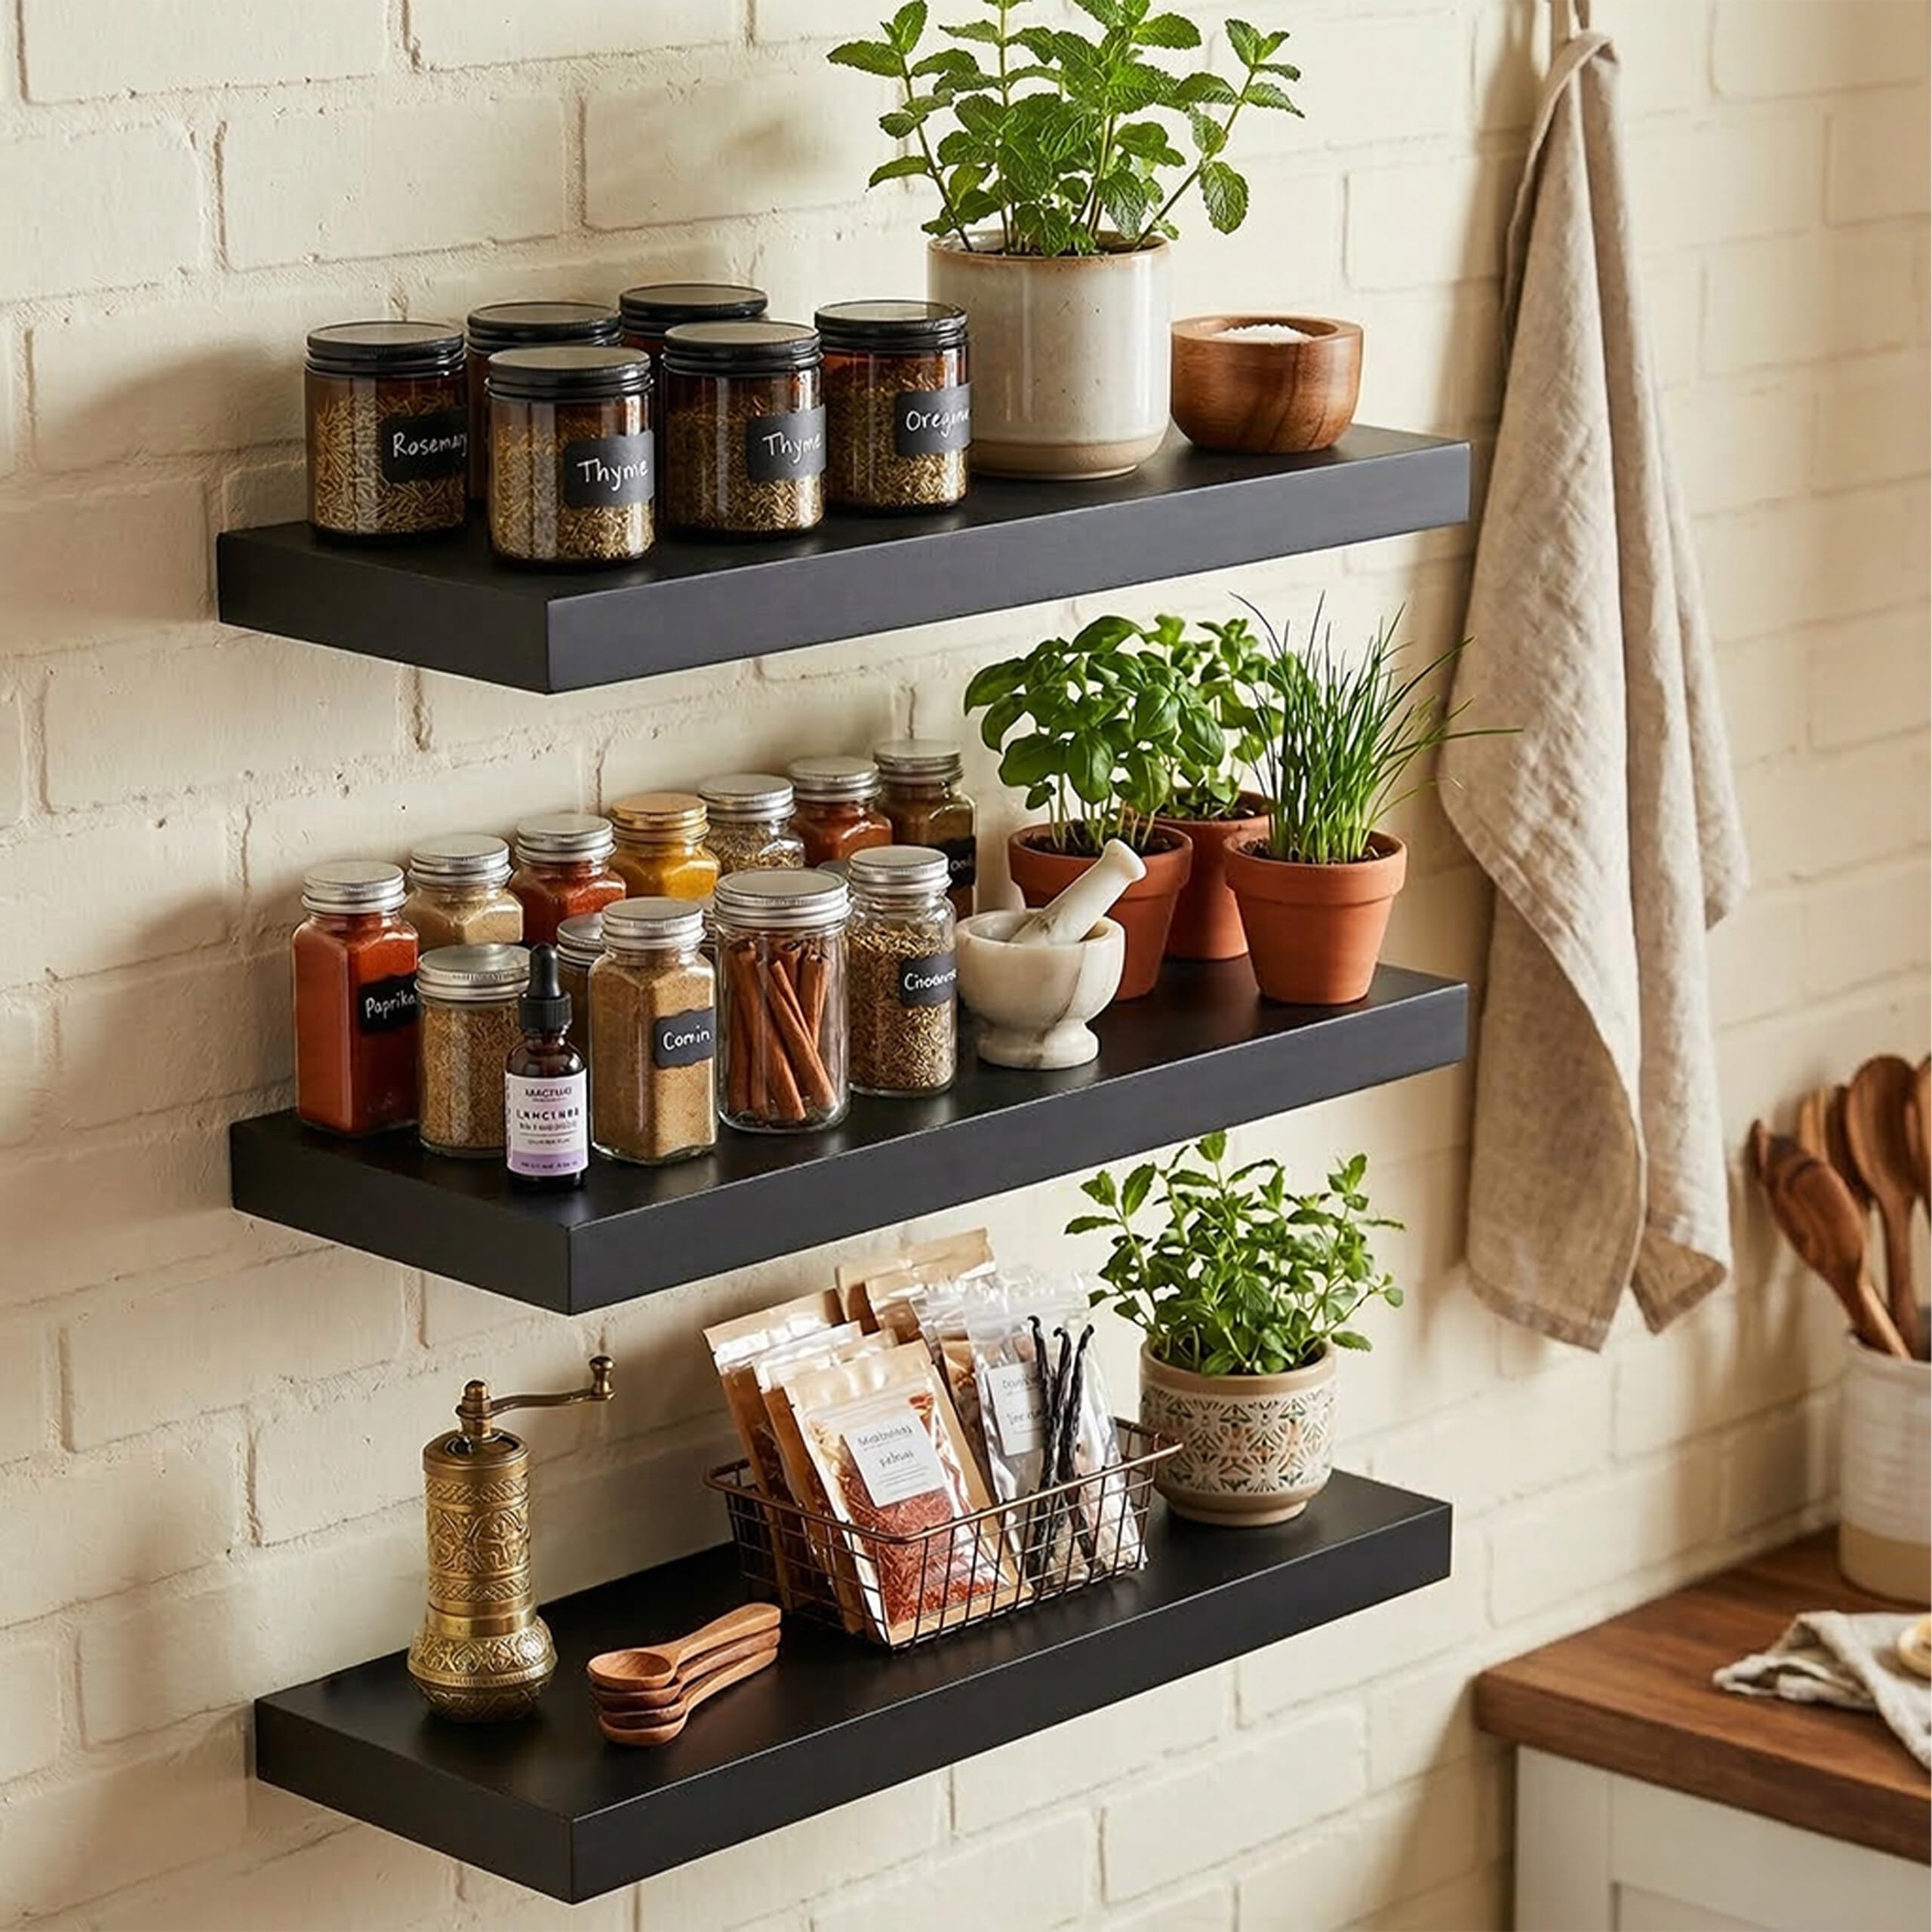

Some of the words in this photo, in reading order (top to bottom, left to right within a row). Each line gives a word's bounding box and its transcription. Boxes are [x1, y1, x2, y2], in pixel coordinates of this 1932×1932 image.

[761, 432, 823, 464] Thyme
[576, 458, 648, 491] Thyme
[365, 990, 416, 1020] Paprika
